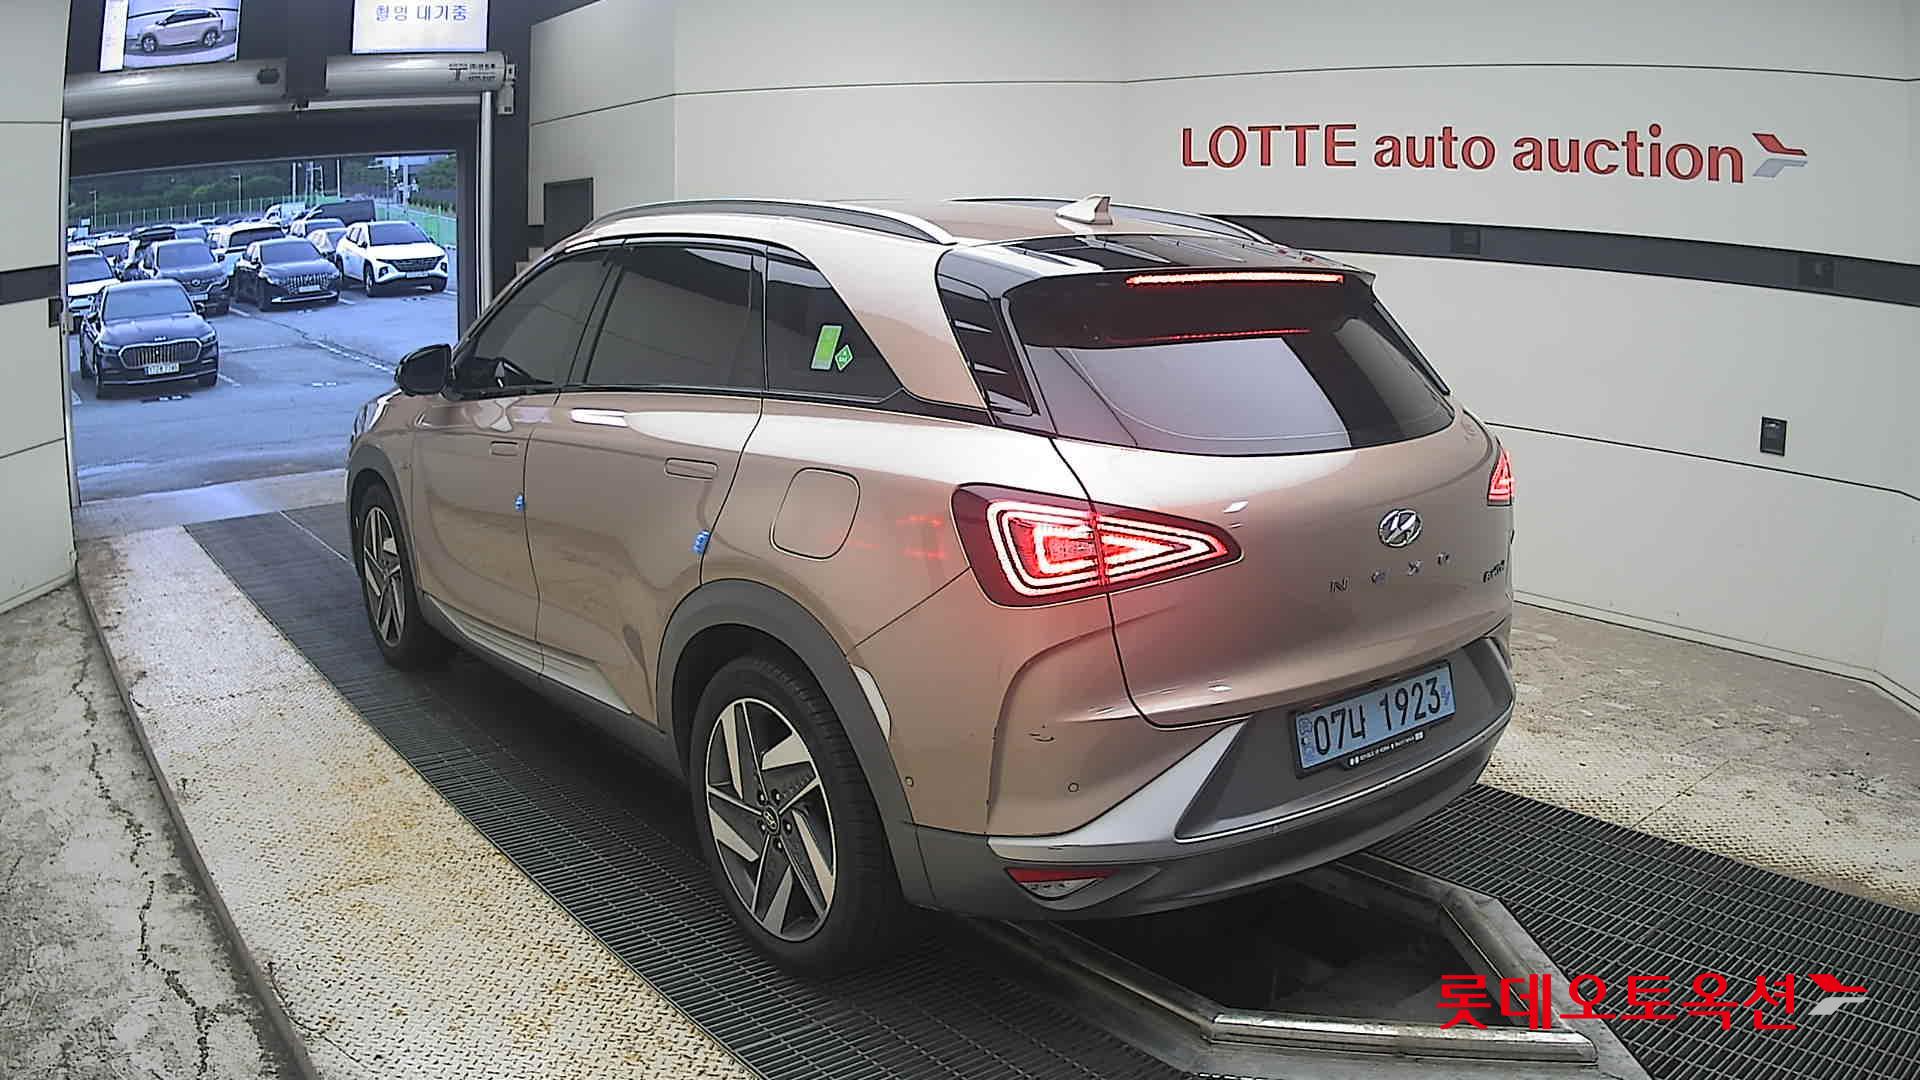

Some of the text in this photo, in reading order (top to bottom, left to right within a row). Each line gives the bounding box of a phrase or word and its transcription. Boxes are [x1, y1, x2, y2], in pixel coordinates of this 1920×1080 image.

[416, 4, 468, 21] 대기중
[1182, 123, 1744, 183] LOTTE auto auction
[1379, 676, 1441, 731] 1923
